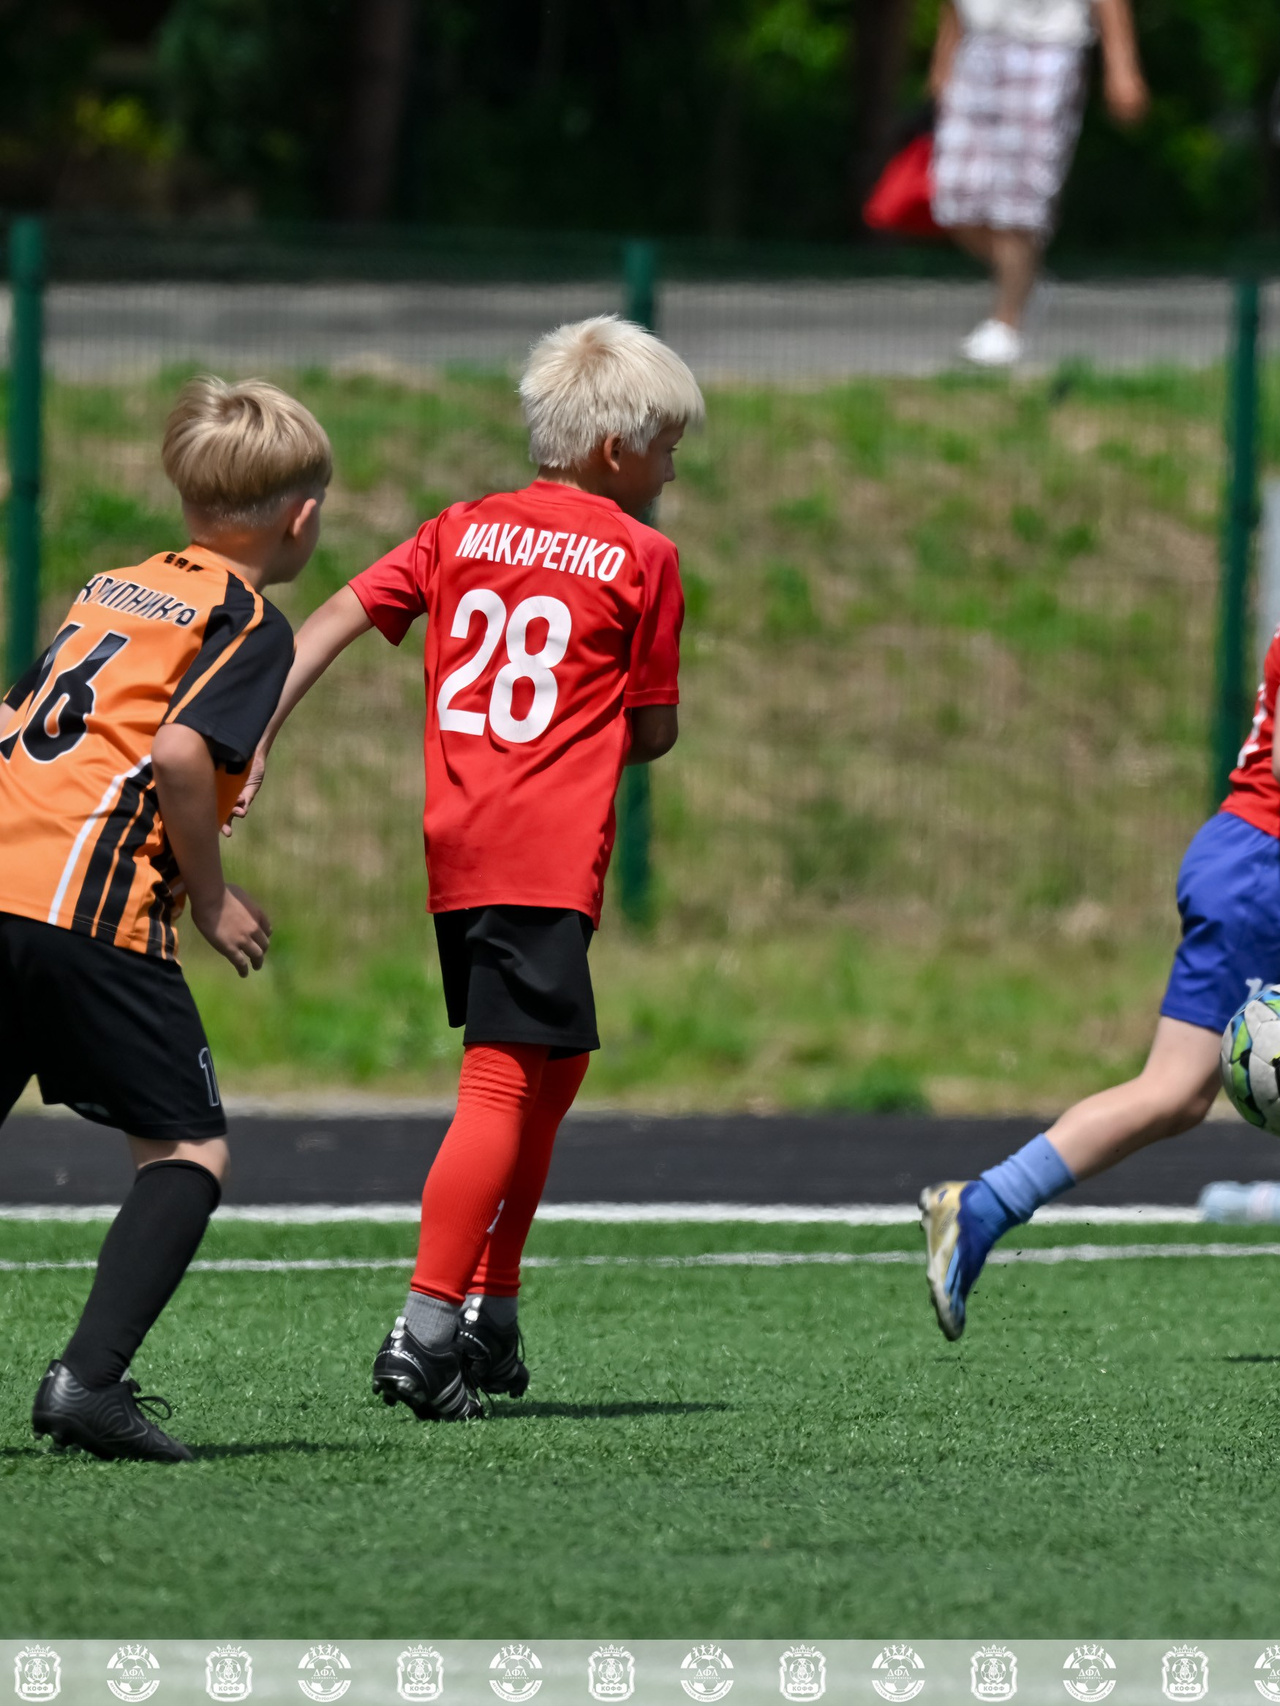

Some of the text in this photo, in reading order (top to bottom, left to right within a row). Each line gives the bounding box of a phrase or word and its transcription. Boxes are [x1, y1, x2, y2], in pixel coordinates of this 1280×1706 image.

[455, 523, 626, 582] МАКАРЕНКО
[0, 621, 131, 765] 16
[437, 588, 573, 744] 28
